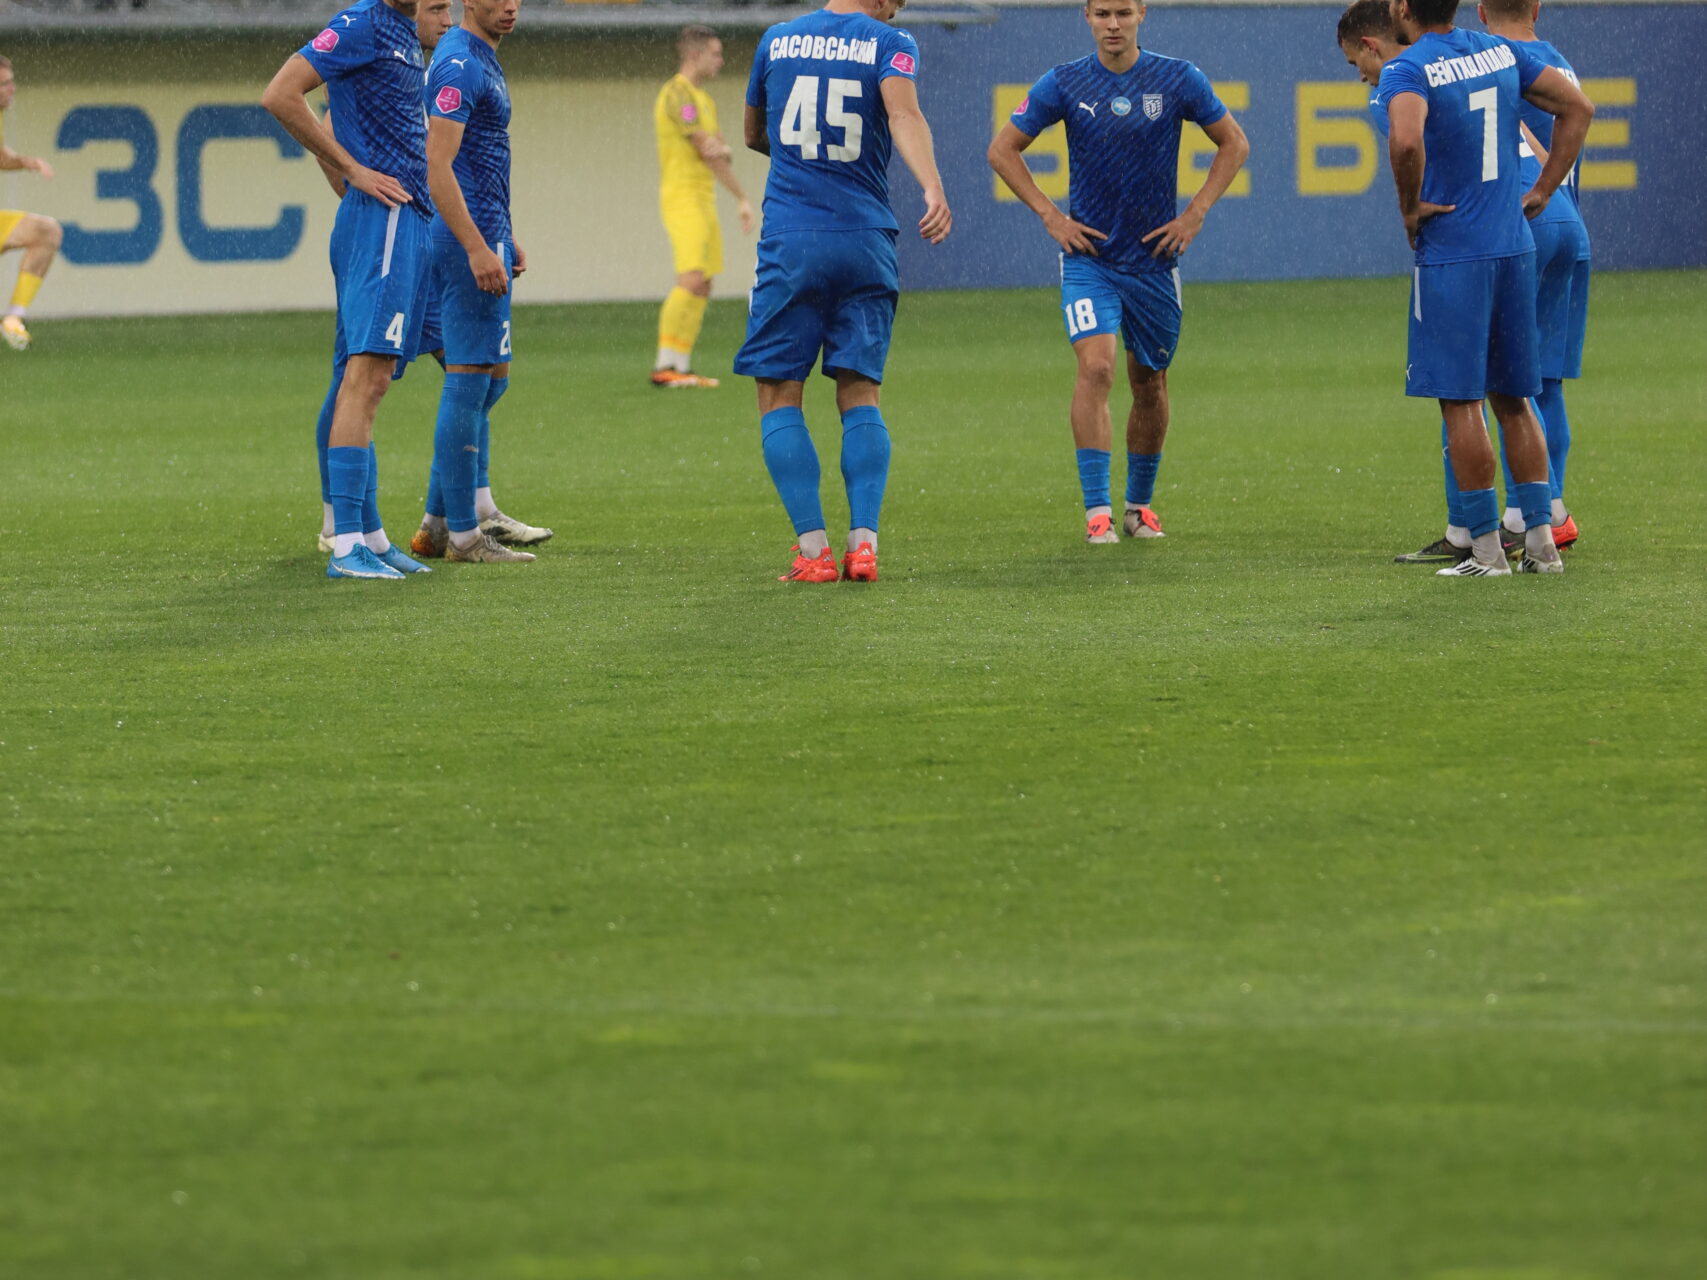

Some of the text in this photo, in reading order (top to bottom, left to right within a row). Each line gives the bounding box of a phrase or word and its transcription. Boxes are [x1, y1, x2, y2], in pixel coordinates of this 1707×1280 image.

[769, 34, 878, 65] САСОВСЬКИЙ
[779, 75, 863, 163] 45
[55, 103, 328, 266] ЗС
[385, 312, 405, 349] 4
[1065, 297, 1098, 337] 18
